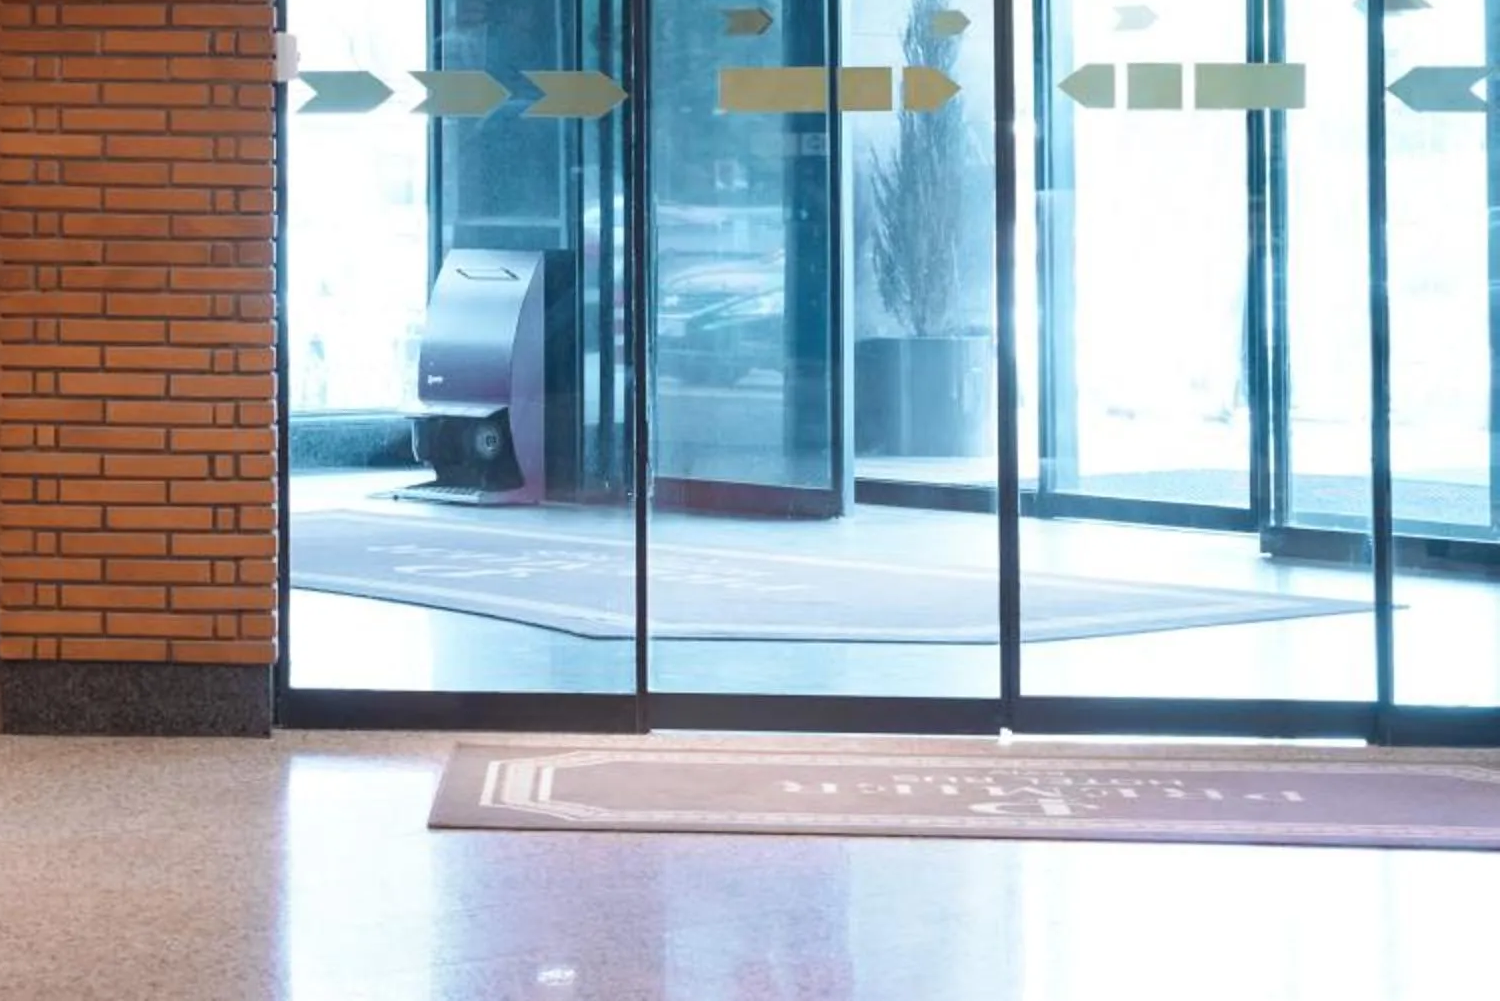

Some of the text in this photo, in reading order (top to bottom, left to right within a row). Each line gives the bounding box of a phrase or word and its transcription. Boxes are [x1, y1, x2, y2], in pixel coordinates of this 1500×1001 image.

[891, 774, 1185, 788] HOTEL RUS
[775, 780, 1304, 801] PREMIER
